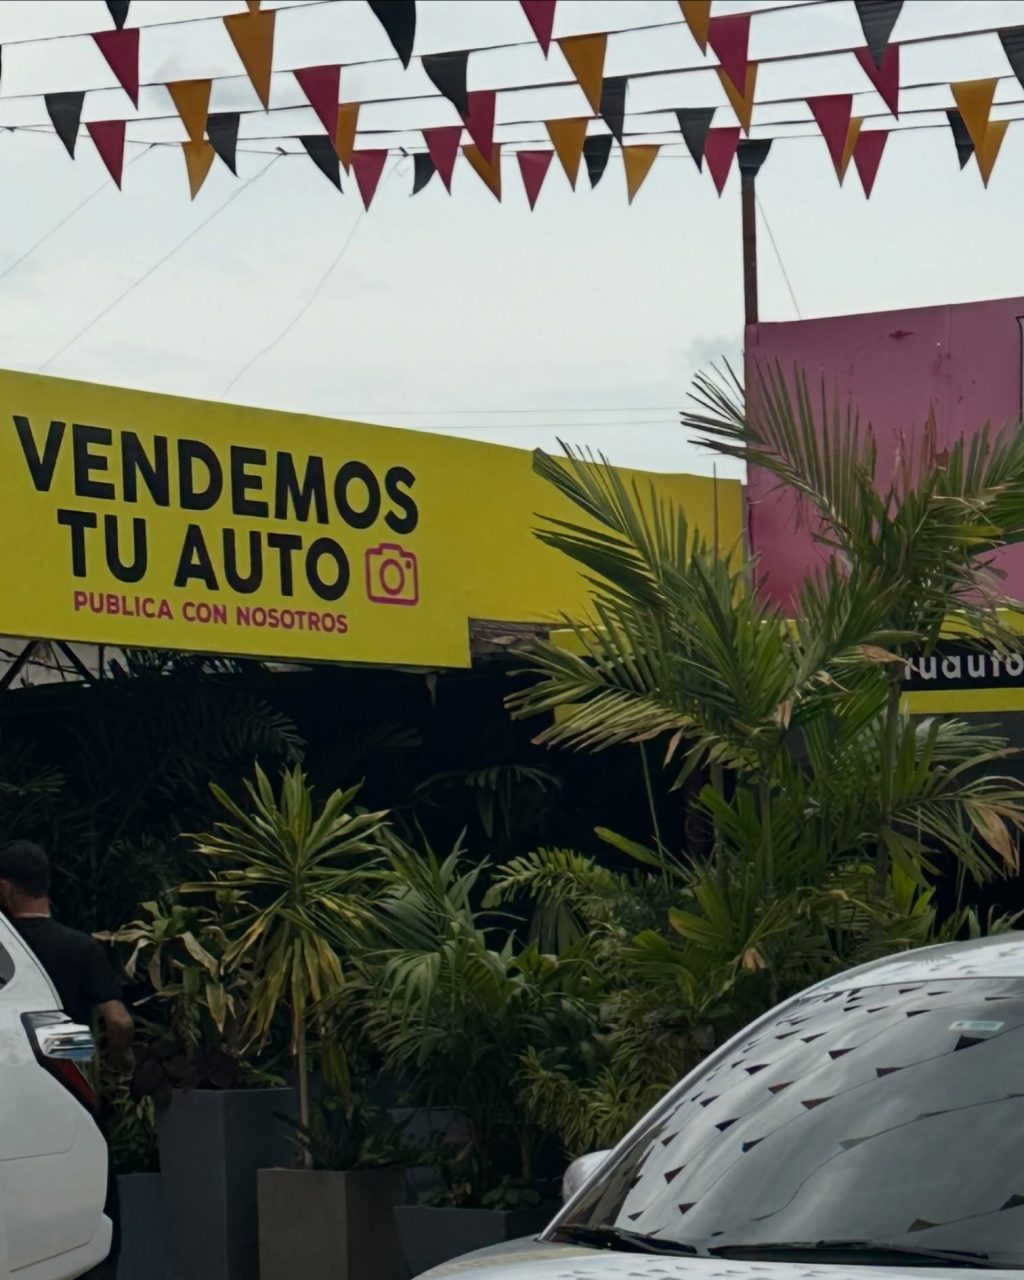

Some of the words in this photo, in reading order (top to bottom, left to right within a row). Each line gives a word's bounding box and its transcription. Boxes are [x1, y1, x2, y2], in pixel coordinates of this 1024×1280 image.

[13, 415, 419, 535] VENDEMOS
[57, 509, 148, 583] TU
[174, 523, 350, 601] AUTO
[73, 591, 174, 620] PUBLICA
[183, 601, 228, 625] CON
[236, 607, 349, 635] NOSOTROS
[904, 649, 1024, 681] tuauto
